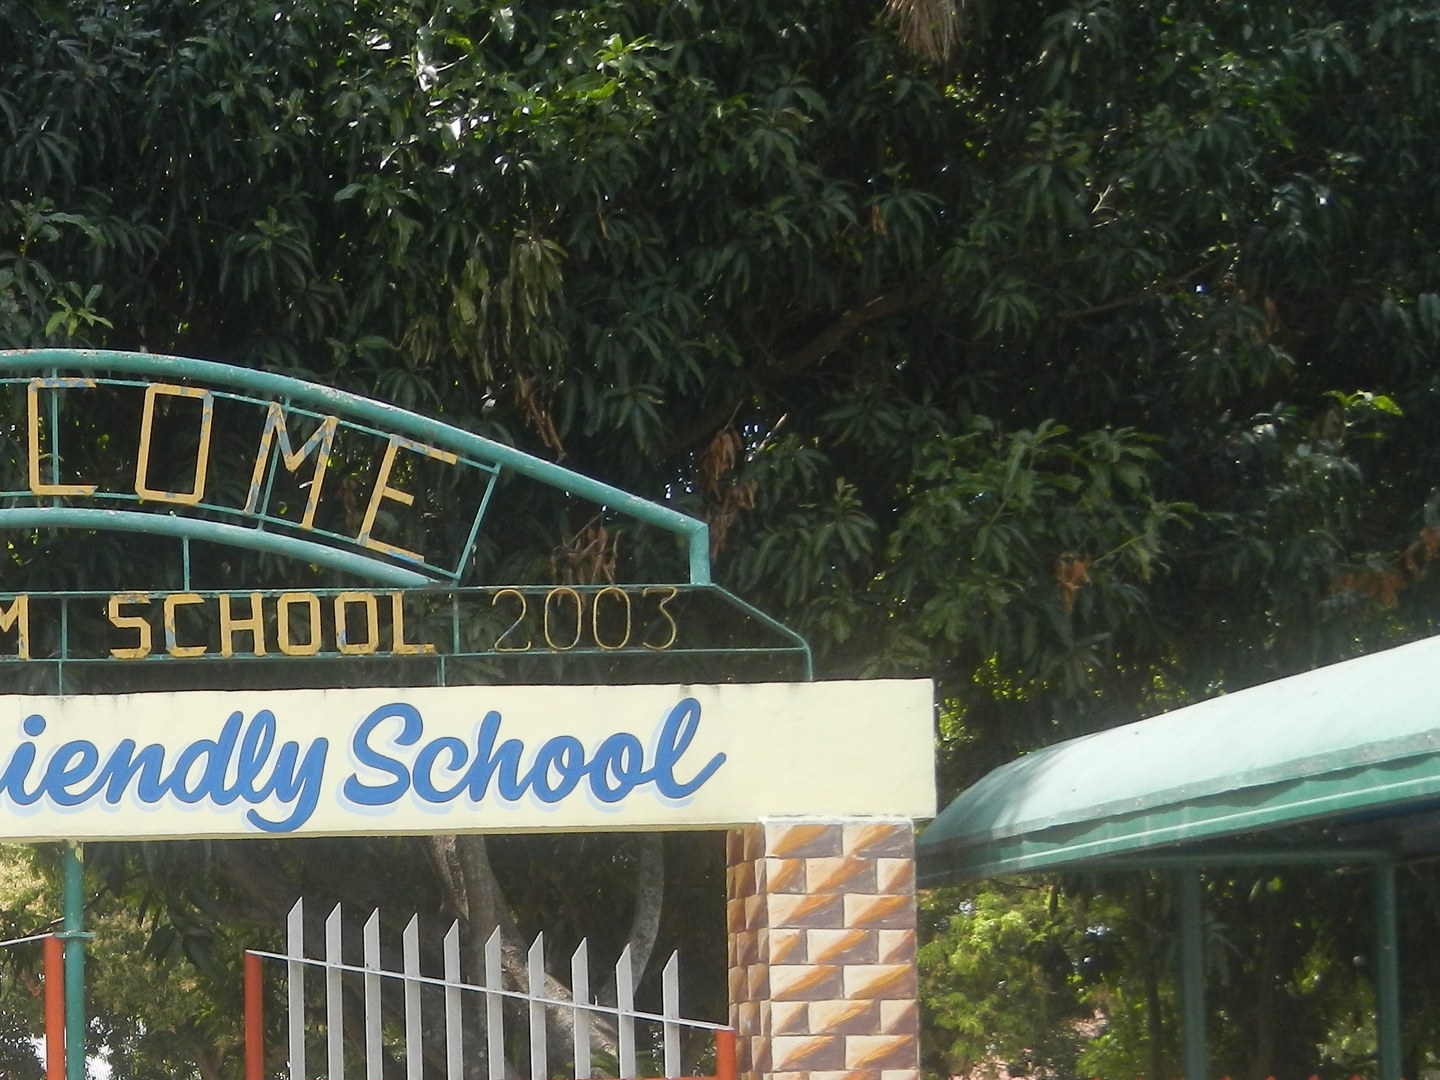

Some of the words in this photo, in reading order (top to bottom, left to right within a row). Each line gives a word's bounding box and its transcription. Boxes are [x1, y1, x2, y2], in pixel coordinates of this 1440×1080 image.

[109, 591, 435, 660] SCHOOL
[492, 587, 678, 652] 2003
[344, 697, 726, 806] School
